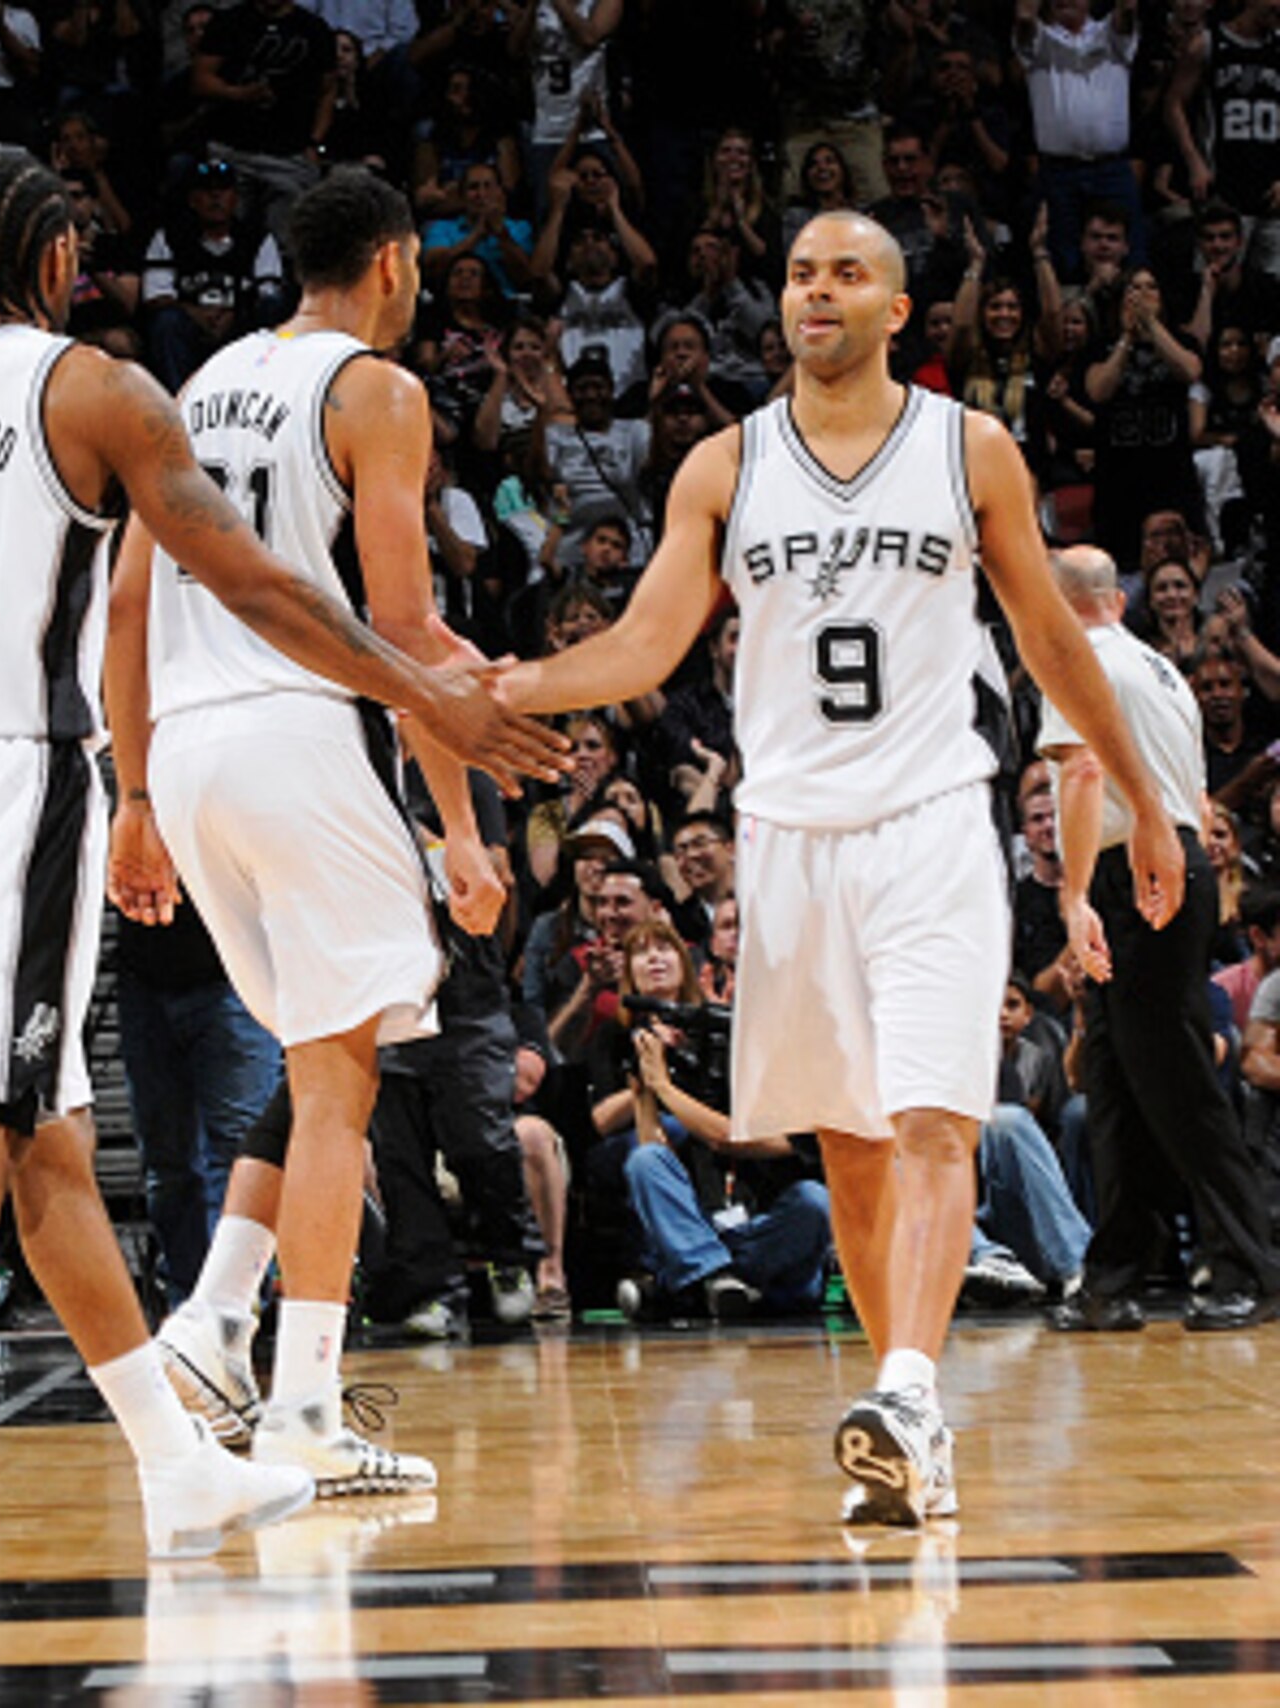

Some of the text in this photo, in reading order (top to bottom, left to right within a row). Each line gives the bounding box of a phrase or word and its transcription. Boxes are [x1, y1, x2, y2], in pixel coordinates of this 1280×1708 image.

[1222, 99, 1278, 142] 20
[190, 388, 290, 442] DUNCAN
[742, 527, 952, 600] SPURS
[811, 618, 890, 732] 9
